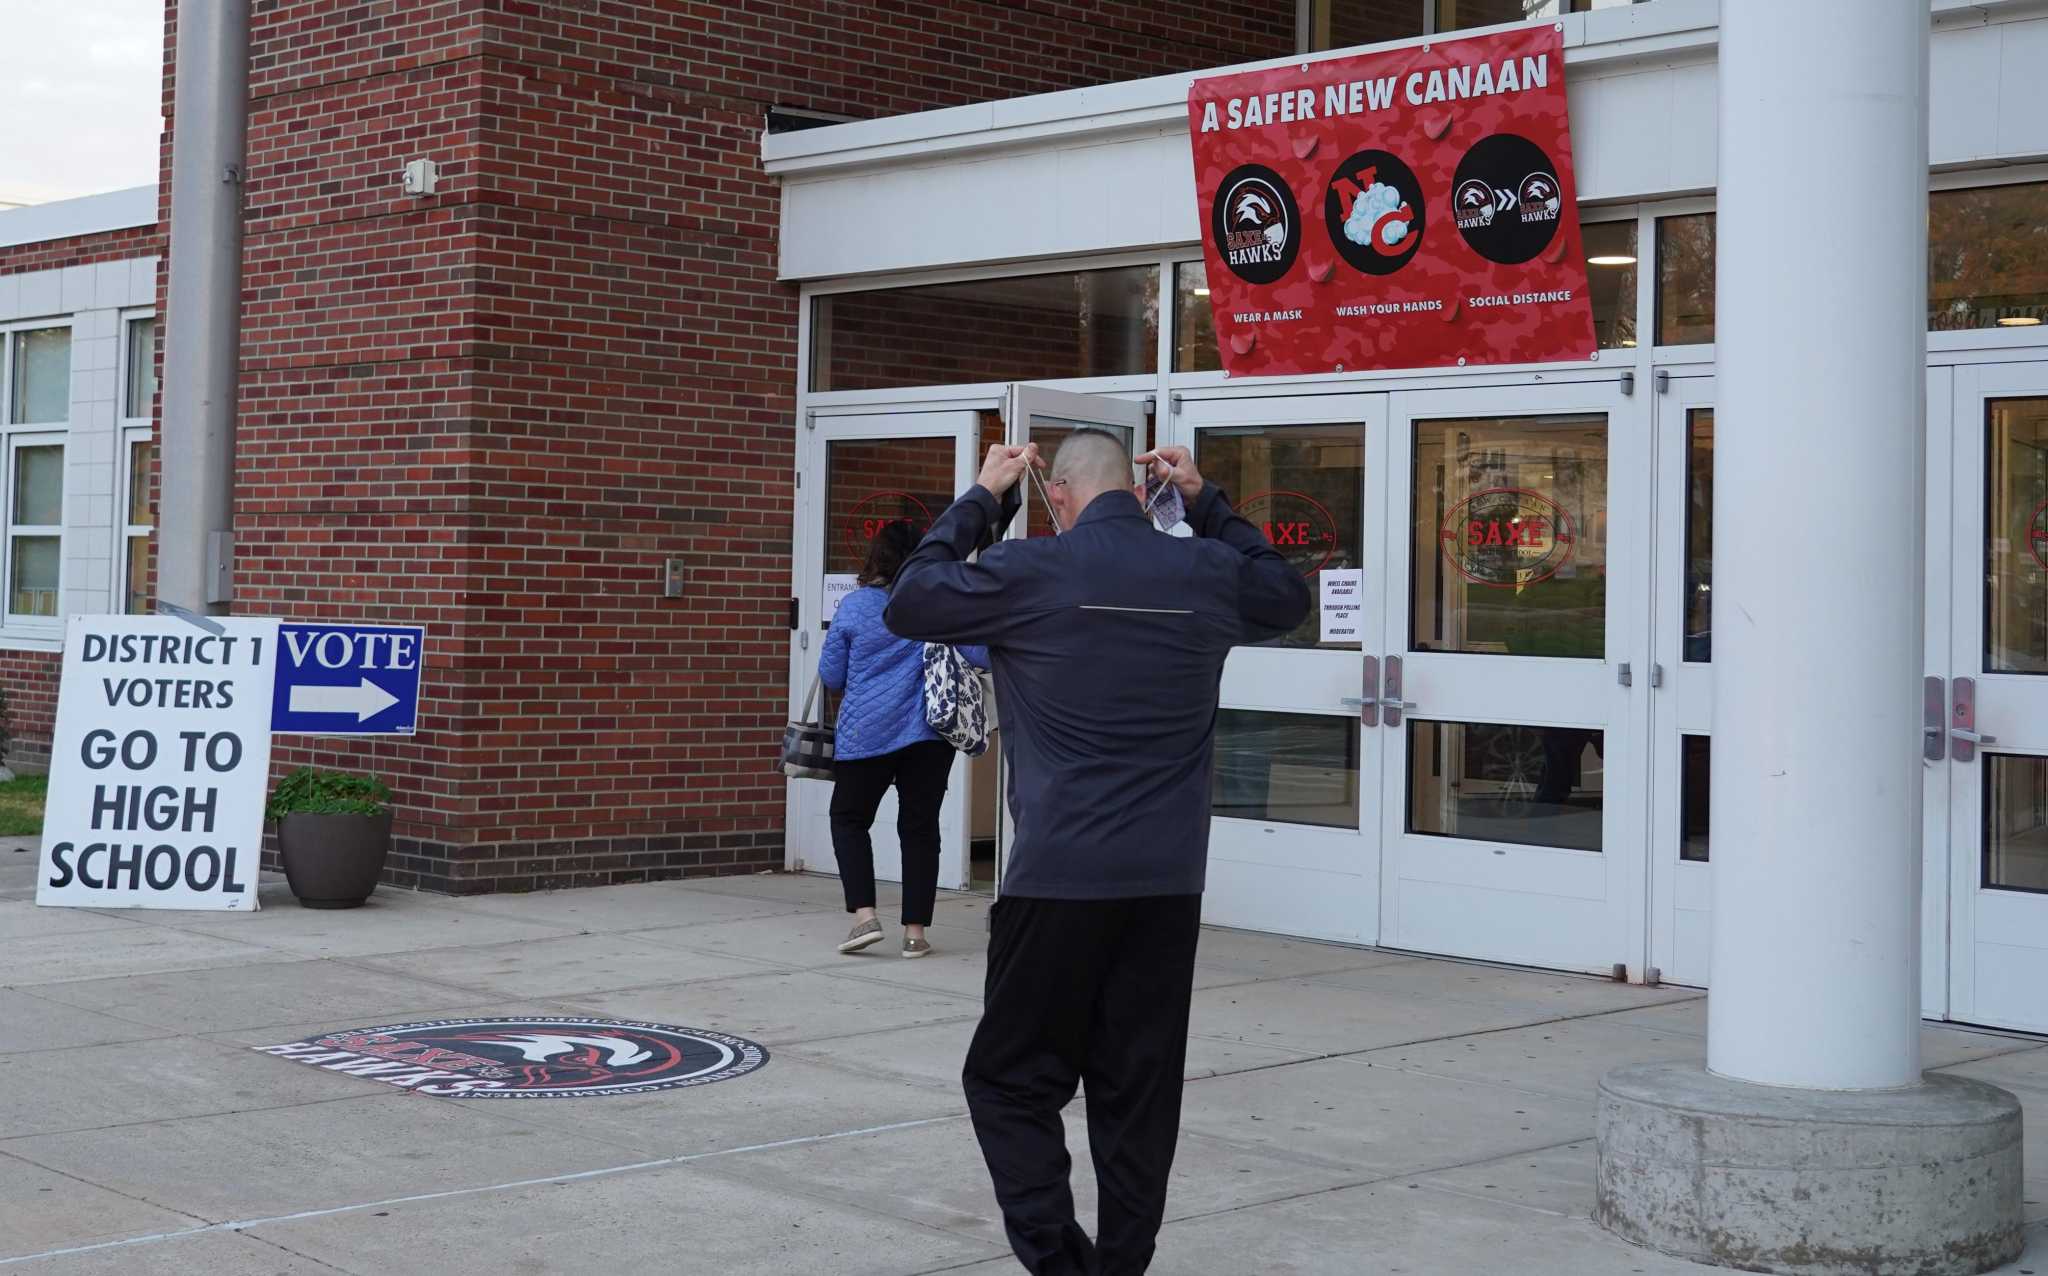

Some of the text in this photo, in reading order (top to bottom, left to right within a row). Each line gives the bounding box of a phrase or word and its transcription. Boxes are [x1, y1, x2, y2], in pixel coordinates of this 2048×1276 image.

[1201, 54, 1548, 133] A SAFER NEW CANAAN
[1457, 215, 1492, 229] HAWKS
[1521, 207, 1557, 223] HAWKS
[1227, 230, 1263, 251] SAXE
[1229, 241, 1282, 265] HAWKS
[1336, 300, 1443, 317] WASH YOUR HANDS
[1469, 290, 1572, 308] SOCIAL DISTANCE
[1233, 310, 1303, 323] WEAR A MASK
[1262, 521, 1310, 545] AXE
[1467, 519, 1544, 546] SAXE
[827, 583, 859, 592] ENTRAN
[82, 634, 262, 666] DISTRICT 1
[281, 631, 416, 671] VOTE
[102, 678, 234, 709] VOTERS
[80, 729, 243, 773] GO TO
[90, 784, 218, 833] HIGH
[49, 841, 245, 893] SCHOOL
[315, 1033, 505, 1072] SAXE
[250, 1041, 508, 1095] HAWKS
